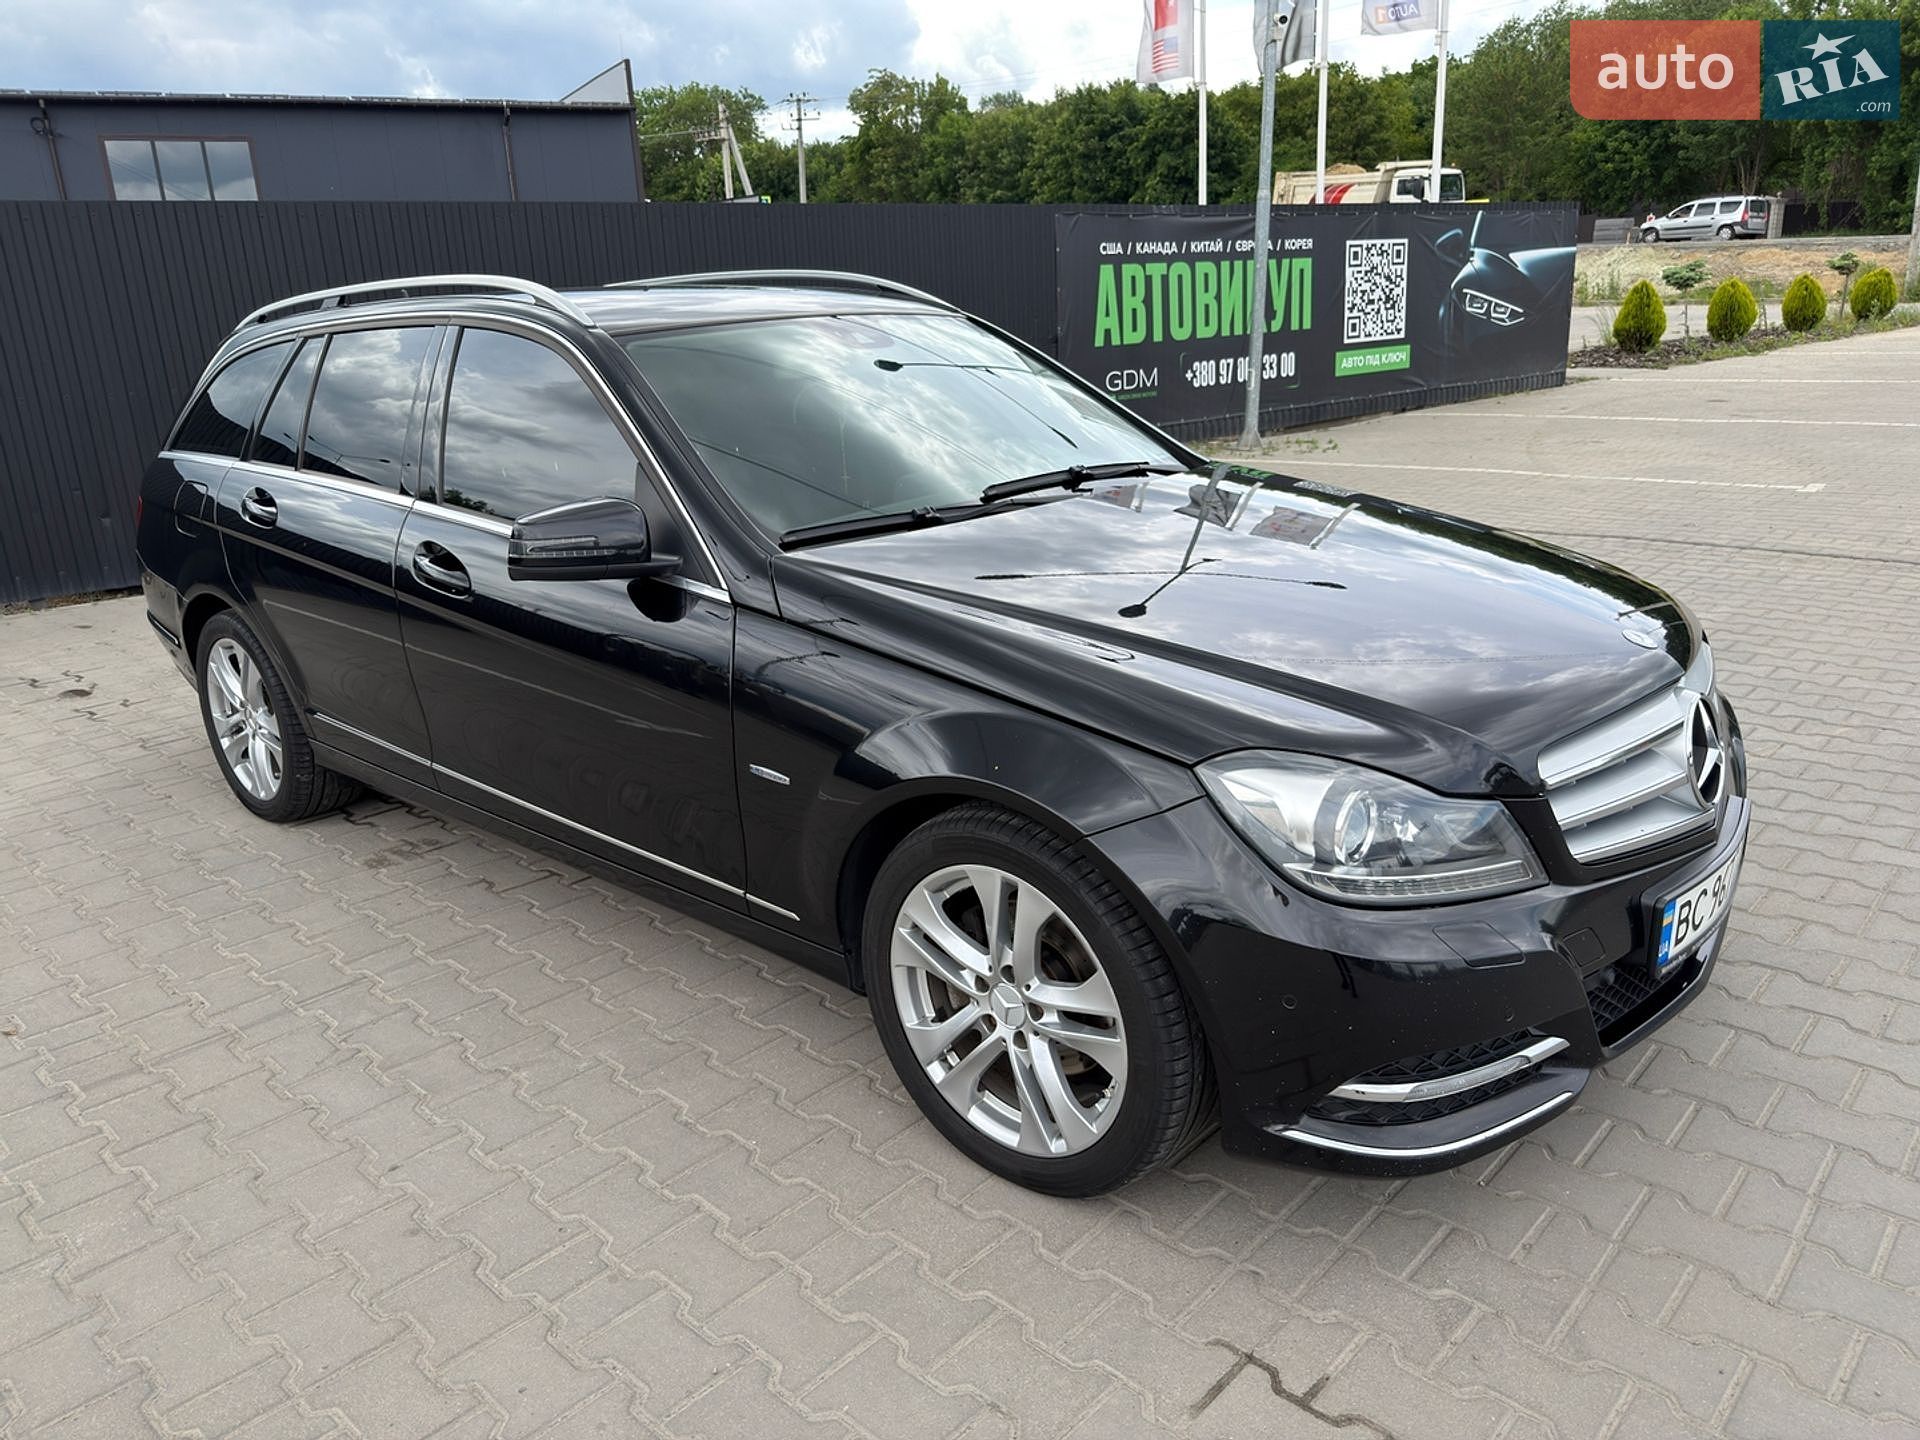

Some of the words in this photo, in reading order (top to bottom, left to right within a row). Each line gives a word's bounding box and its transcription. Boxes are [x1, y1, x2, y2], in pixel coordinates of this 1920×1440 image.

[1099, 242, 1124, 255] США
[1135, 241, 1178, 255] КАНАДА
[1190, 238, 1223, 252] КИТАЙ
[1235, 239, 1273, 251] ЄВРА
[1284, 238, 1313, 250] КОРЕЯ
[1185, 360, 1215, 387] +380
[1219, 358, 1234, 385] 97
[1262, 354, 1277, 380] 33
[1280, 351, 1295, 377] 00
[1342, 356, 1364, 369] АВТО
[1381, 351, 1407, 364] КЛЮЧ
[1105, 367, 1158, 391] GDM
[1674, 888, 1707, 948] BC
